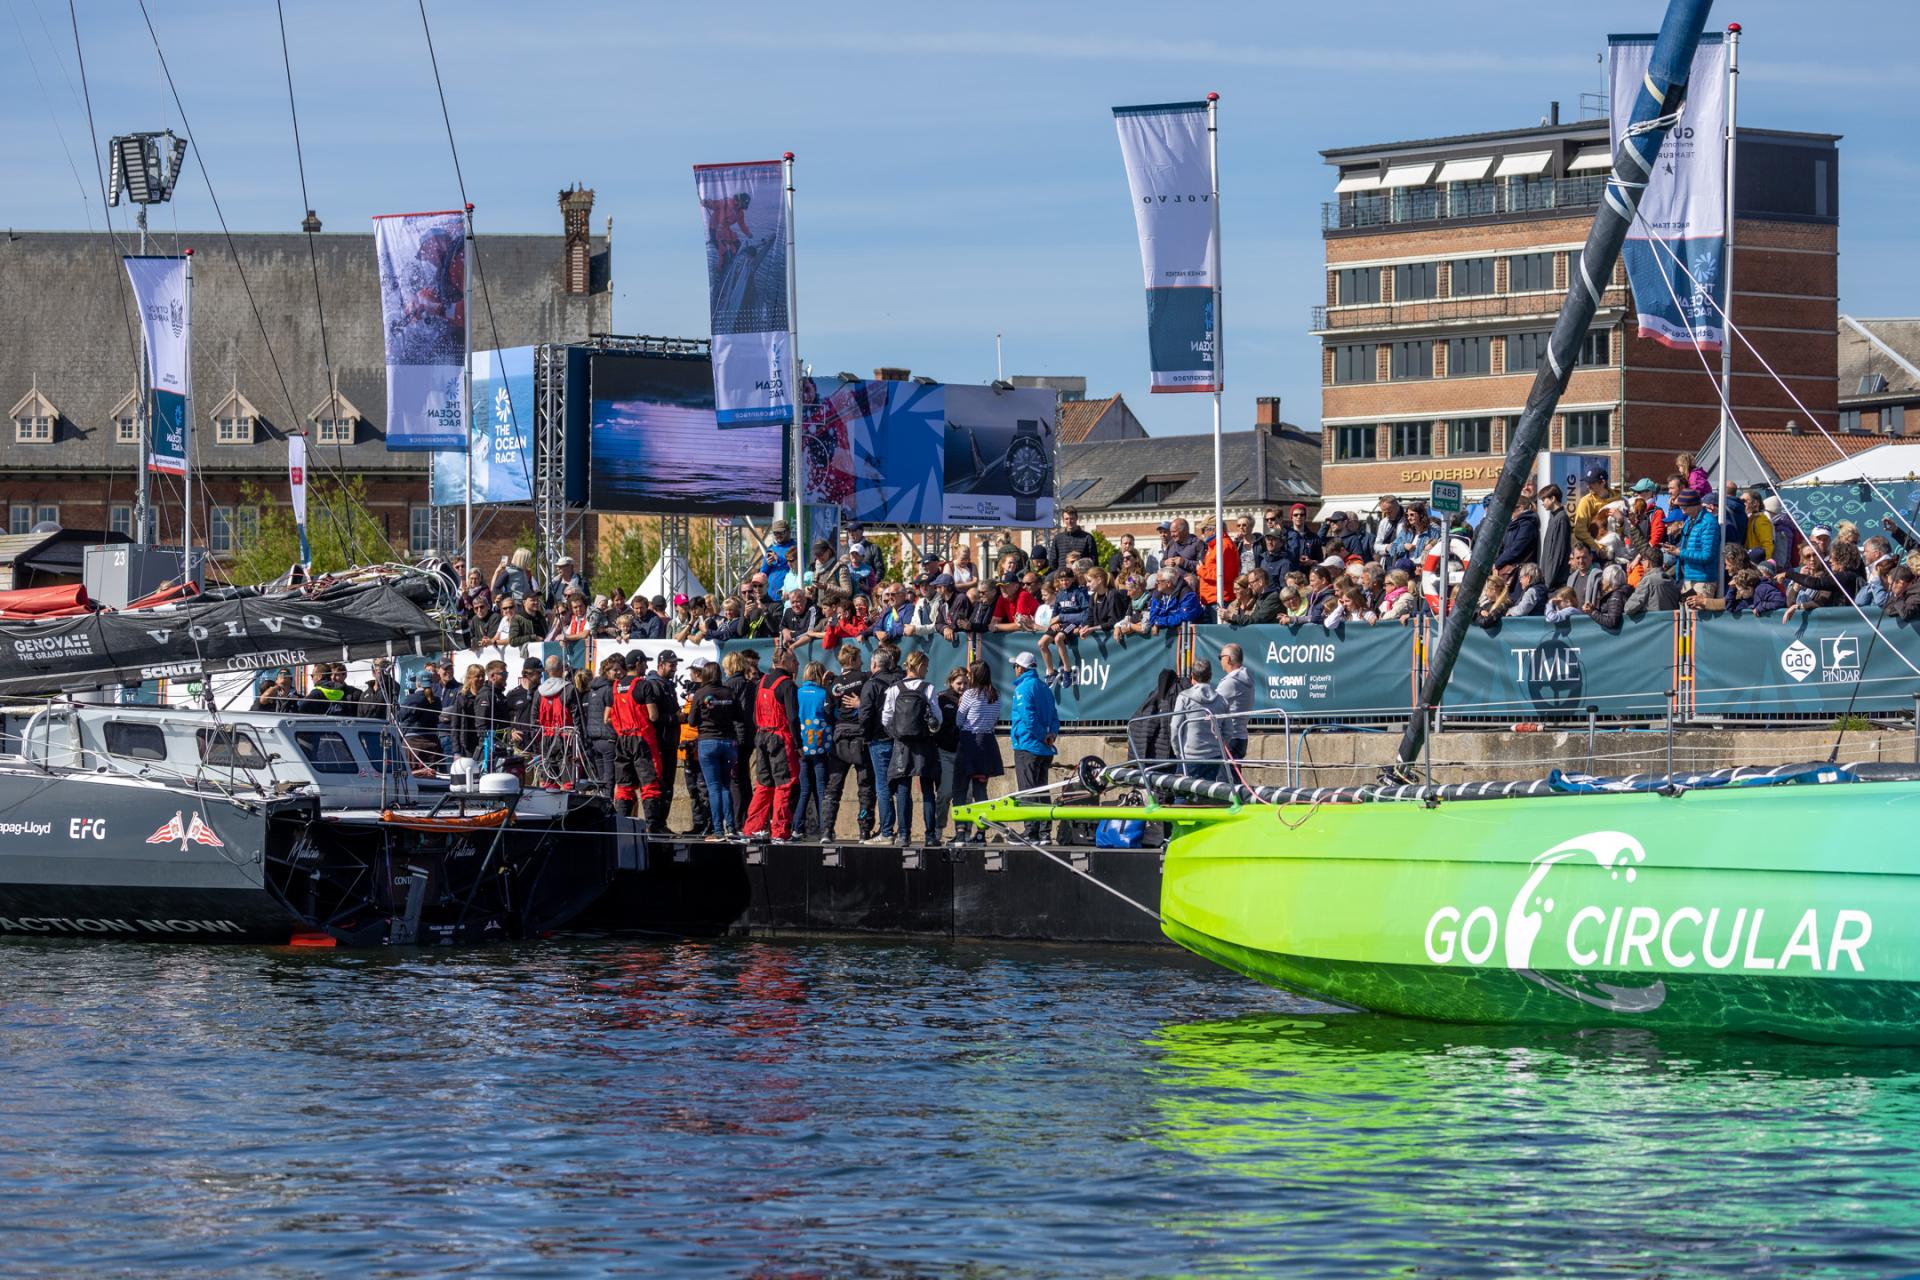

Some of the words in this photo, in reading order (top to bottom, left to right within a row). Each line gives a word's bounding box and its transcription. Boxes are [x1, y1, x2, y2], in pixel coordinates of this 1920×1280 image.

[495, 424, 510, 436] THE
[495, 436, 527, 450] OCEAN
[495, 452, 517, 463] RACE
[114, 551, 125, 566] 23
[146, 614, 322, 644] VOLVO
[14, 635, 74, 653] GENOVA
[1265, 641, 1335, 663] Acronis
[17, 653, 34, 661] THE
[35, 650, 63, 659] GRAND
[64, 647, 93, 656] FINALE
[227, 650, 309, 671] CONTAINER
[1511, 647, 1580, 682] TIME
[1822, 669, 1860, 682] PINDAR
[1269, 688, 1298, 699] CLOUD
[69, 817, 106, 840] EFG
[0, 916, 138, 932] ACTION
[135, 918, 247, 933] NOW!
[1424, 906, 1498, 964] GO
[1566, 905, 1873, 972] CIRCULAR
